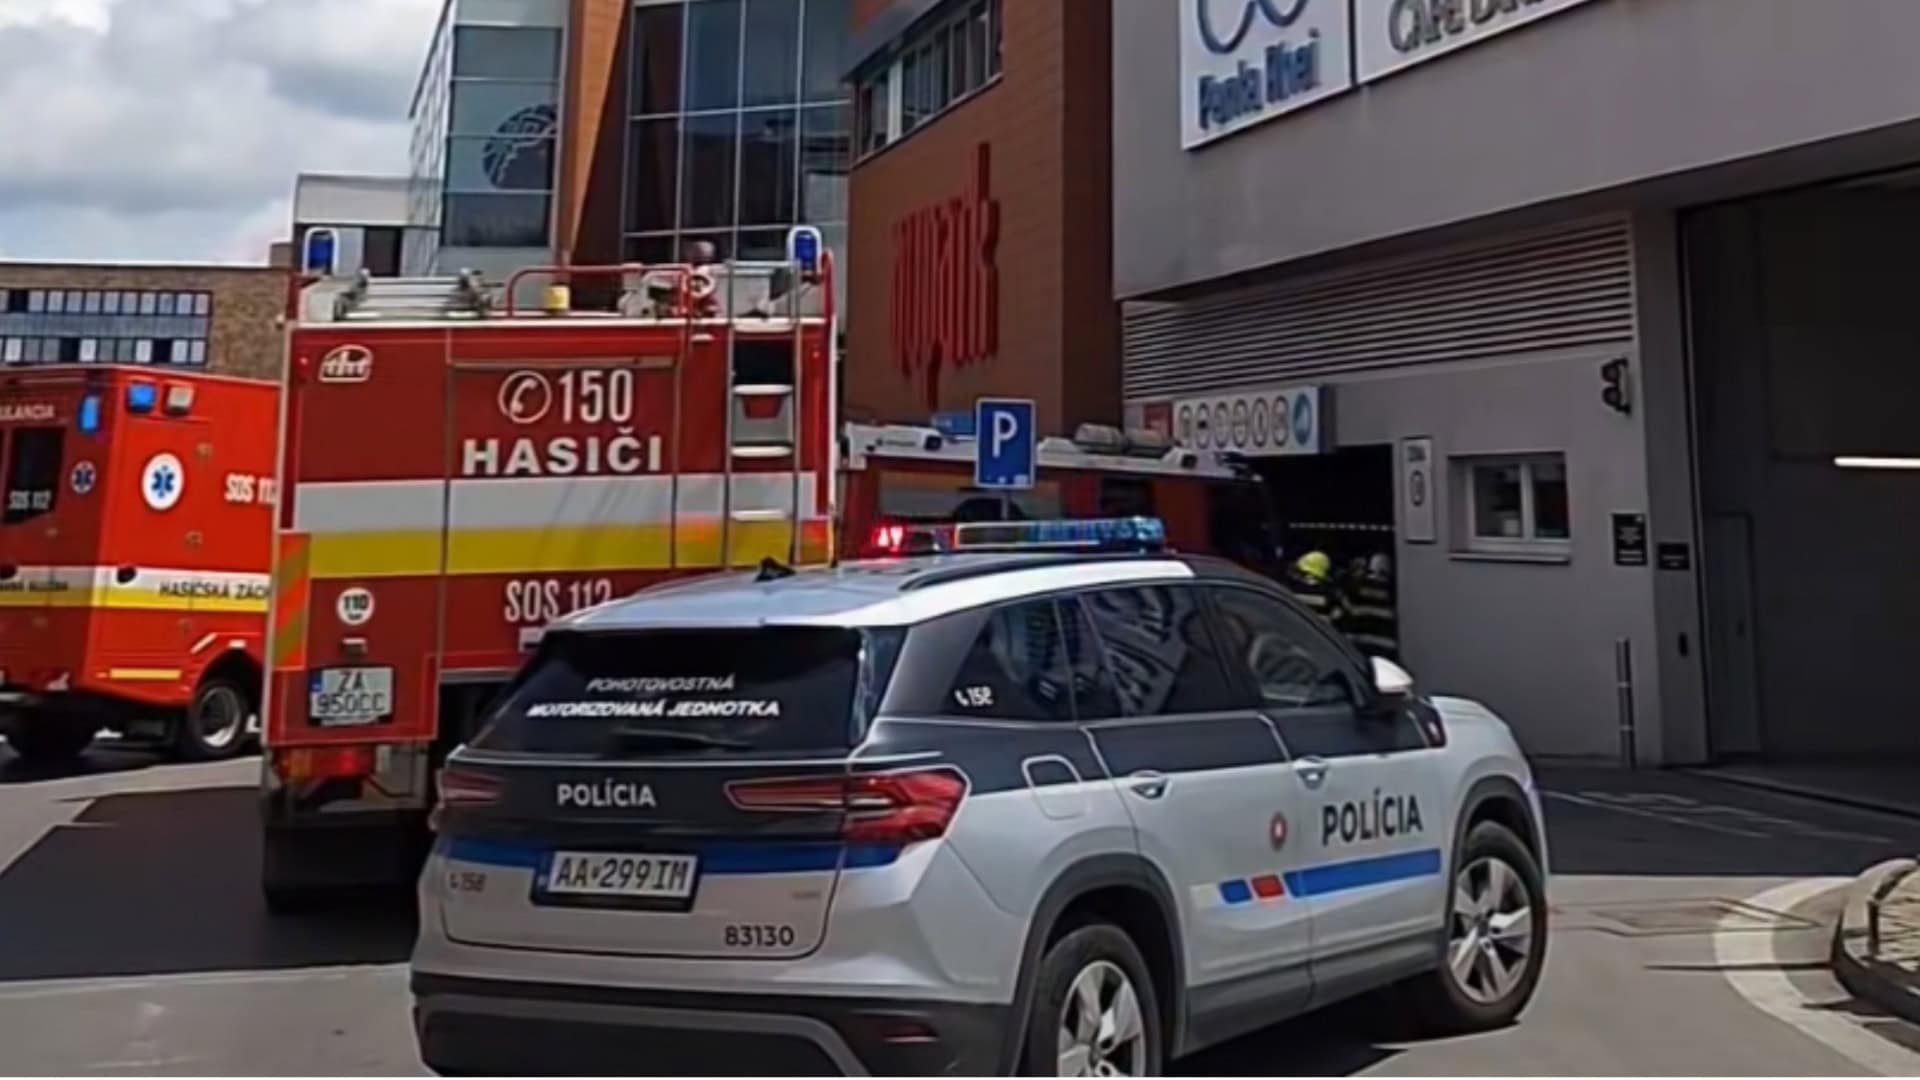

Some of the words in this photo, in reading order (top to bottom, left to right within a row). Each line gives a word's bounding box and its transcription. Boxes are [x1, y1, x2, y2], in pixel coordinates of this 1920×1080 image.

[559, 369, 634, 423] 150
[992, 410, 1017, 458] P
[462, 427, 662, 476] HASIČI
[225, 473, 254, 503] SOS
[504, 580, 560, 622] SOS
[337, 671, 364, 692] ZA
[586, 673, 736, 693] POHOTOVOSTNÁ
[316, 693, 385, 714] 950CC
[526, 699, 667, 717] MOTORIZOVANÁ
[667, 700, 780, 716] JEDNOTKA
[556, 778, 657, 808] POLÍCIA
[1320, 788, 1424, 847] POLÍCIA
[724, 925, 795, 947] 83130
